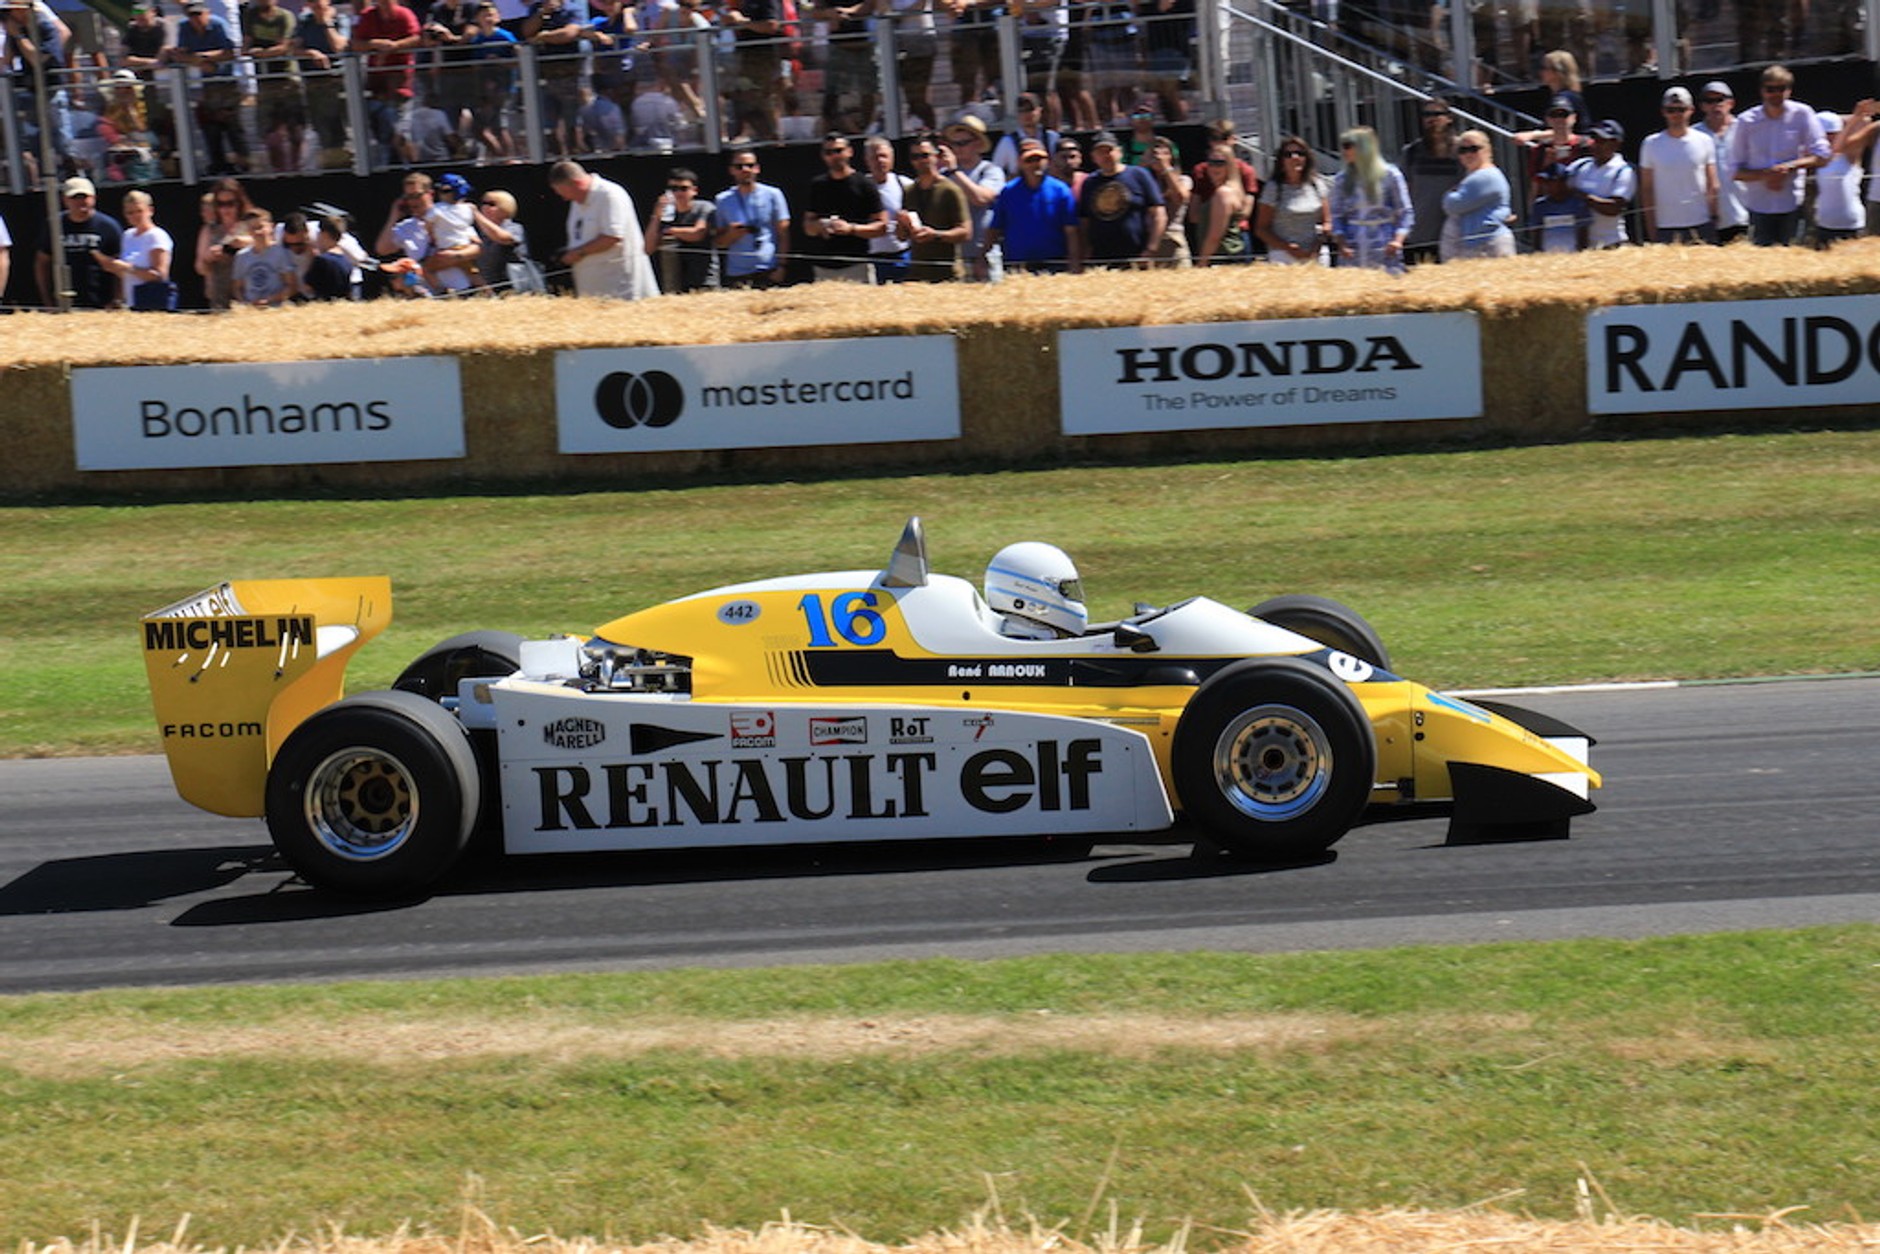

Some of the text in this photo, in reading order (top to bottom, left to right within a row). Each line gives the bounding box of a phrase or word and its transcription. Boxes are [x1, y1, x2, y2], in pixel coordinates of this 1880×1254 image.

[1115, 335, 1423, 384] HONDA
[1604, 315, 1880, 393] RAND
[701, 370, 914, 407] mastercard
[1141, 386, 1398, 411] The Power of Dreams
[140, 394, 392, 438] Bonhams
[724, 604, 753, 619] 442
[797, 591, 887, 647] 16
[144, 617, 312, 650] MICHELIN
[948, 663, 1046, 678] René ARNOUX
[163, 722, 263, 738] FACOM
[813, 725, 864, 738] CHAMPION
[531, 752, 937, 831] RENAULT
[960, 738, 1102, 814] elf
